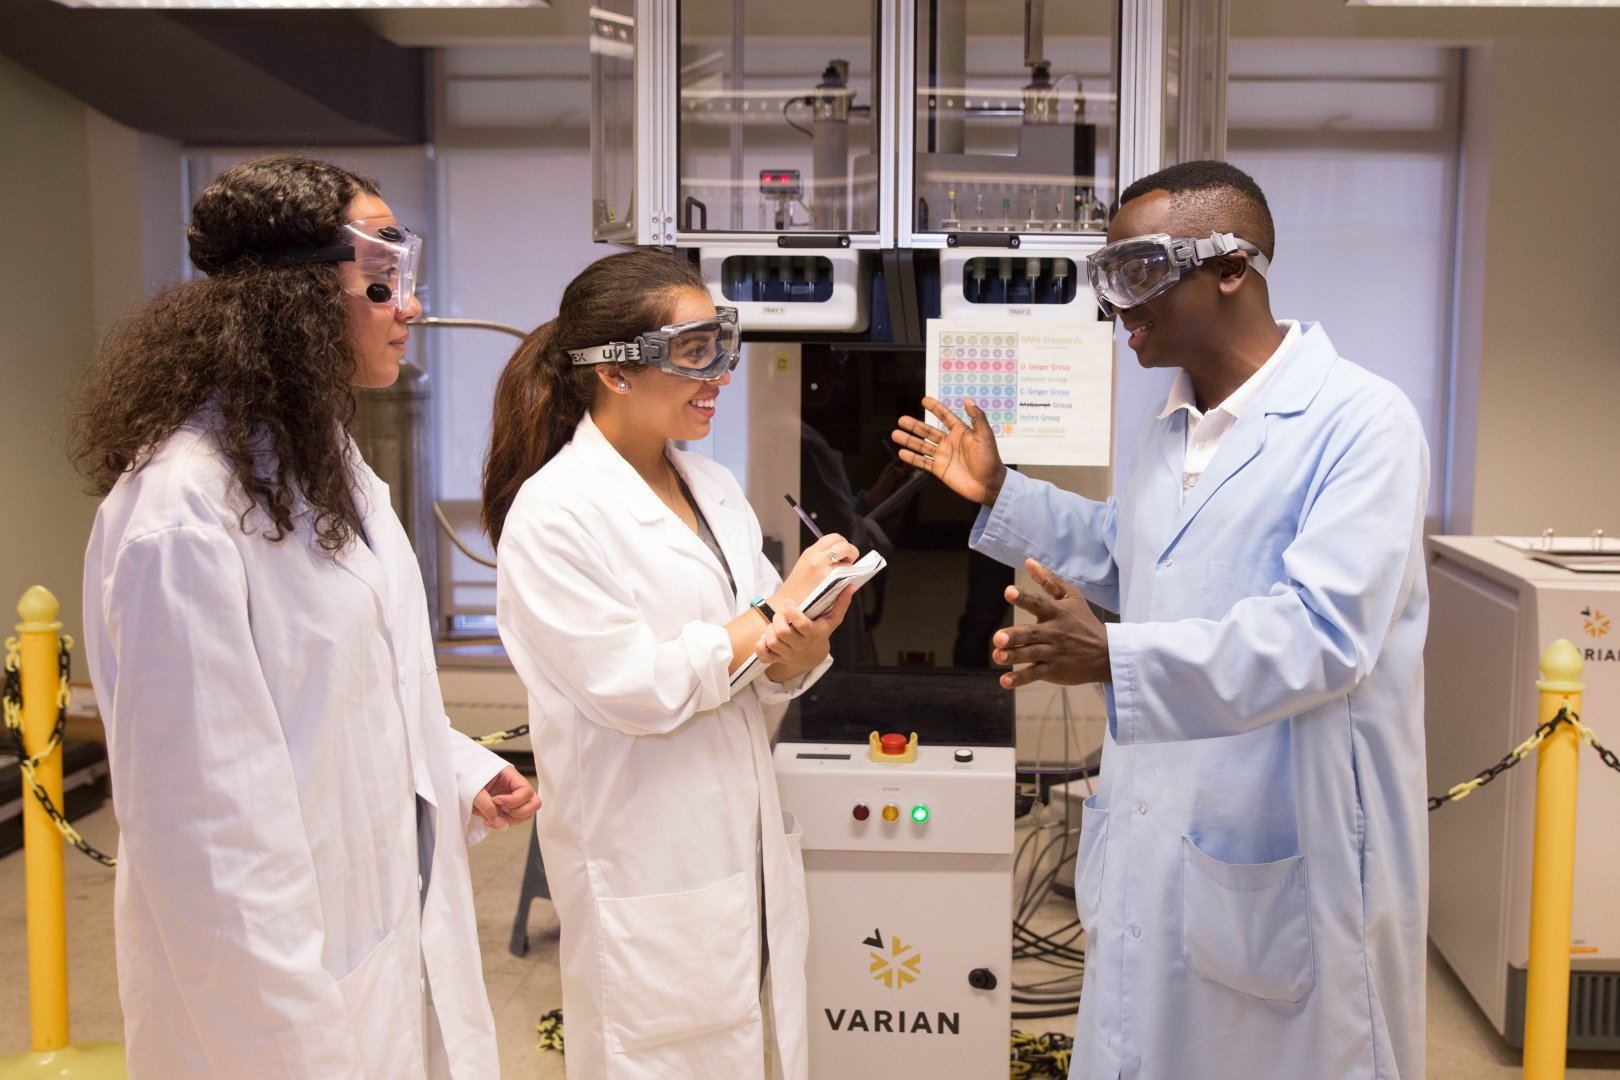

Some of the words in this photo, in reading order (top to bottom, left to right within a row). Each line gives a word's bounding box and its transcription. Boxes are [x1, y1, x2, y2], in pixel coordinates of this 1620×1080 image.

[1021, 336, 1041, 344] NMR
[1042, 336, 1082, 344] Standards
[1050, 363, 1071, 372] Group
[1047, 375, 1068, 384] Group
[1049, 388, 1070, 397] Group
[1052, 401, 1073, 410] Group
[1040, 414, 1061, 423] Group
[824, 1008, 959, 1034] VARIAN
